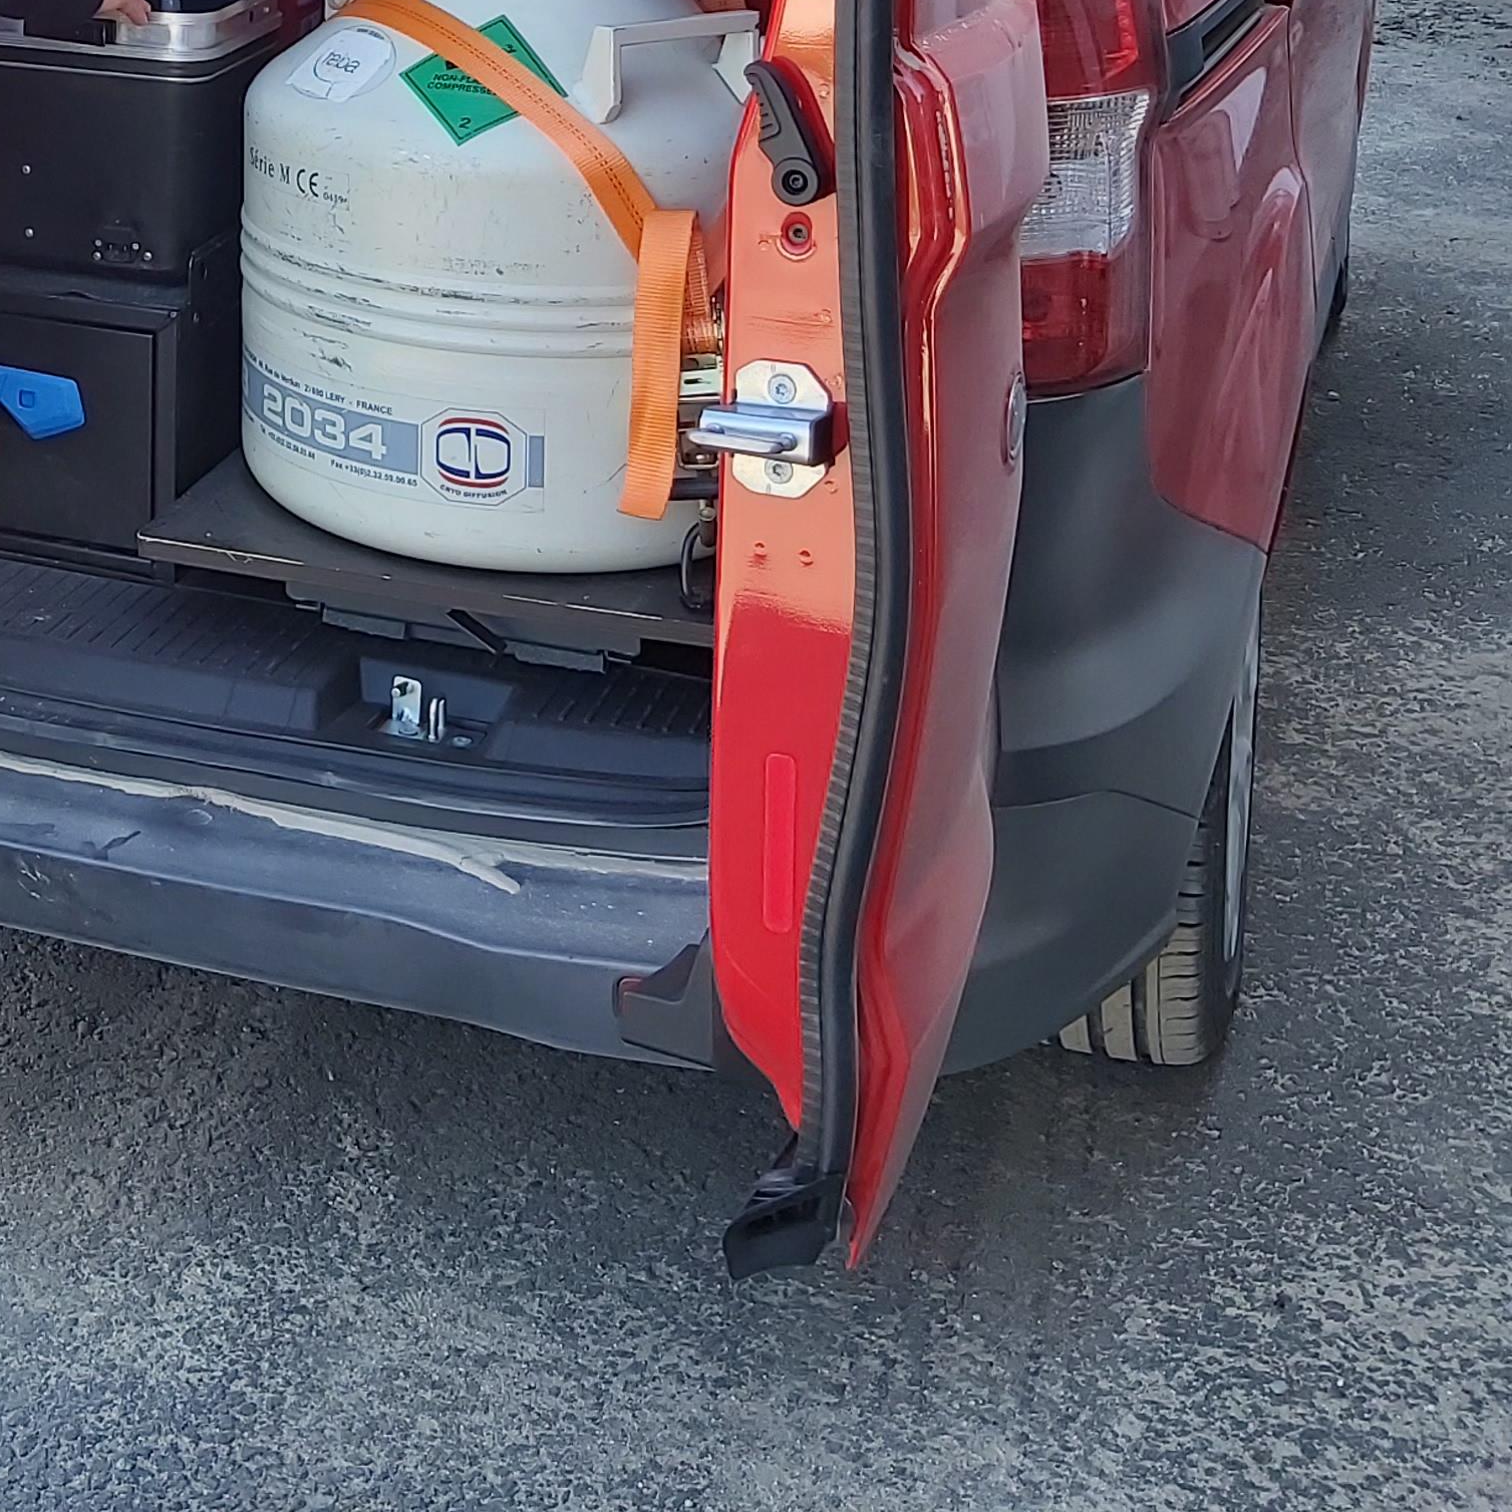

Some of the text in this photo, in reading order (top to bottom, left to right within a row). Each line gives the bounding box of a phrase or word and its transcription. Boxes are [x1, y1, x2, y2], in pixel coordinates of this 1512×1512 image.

[458, 116, 473, 130] 2
[279, 162, 291, 185] M
[356, 399, 393, 416] FRANCE
[263, 383, 387, 461] 2034
